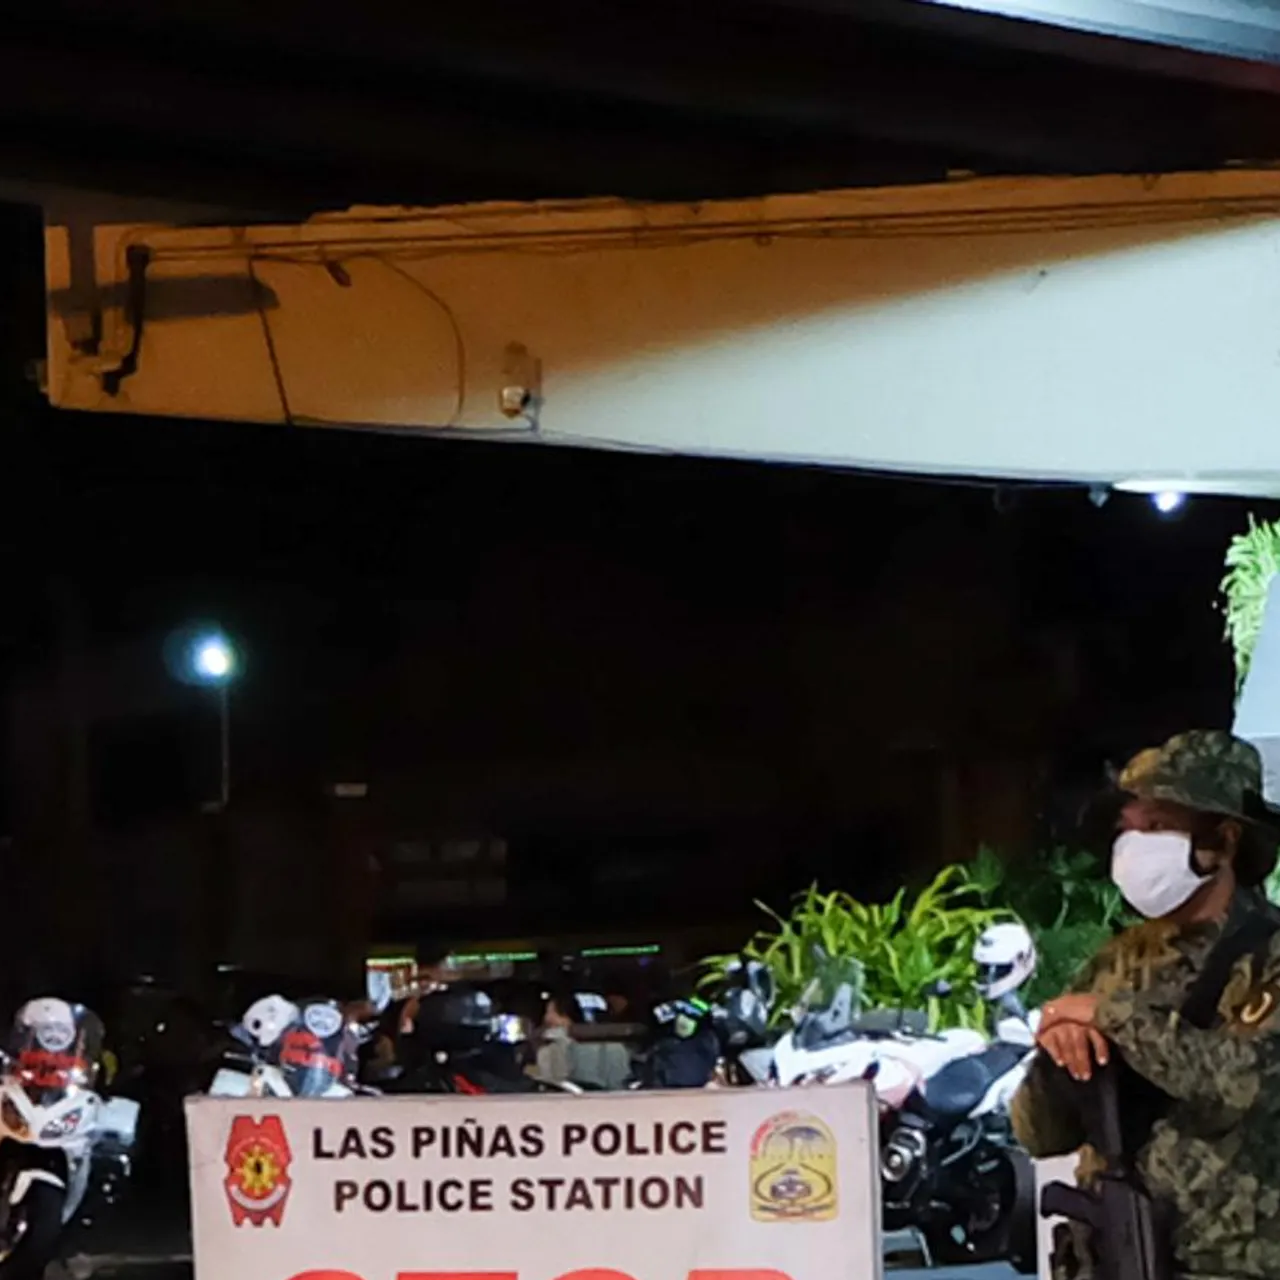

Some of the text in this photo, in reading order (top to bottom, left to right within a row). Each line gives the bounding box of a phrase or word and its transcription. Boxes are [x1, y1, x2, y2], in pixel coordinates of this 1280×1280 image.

[312, 1118, 727, 1160] LAS PIÑAS POLICE
[334, 1175, 705, 1213] POLICE STATION
